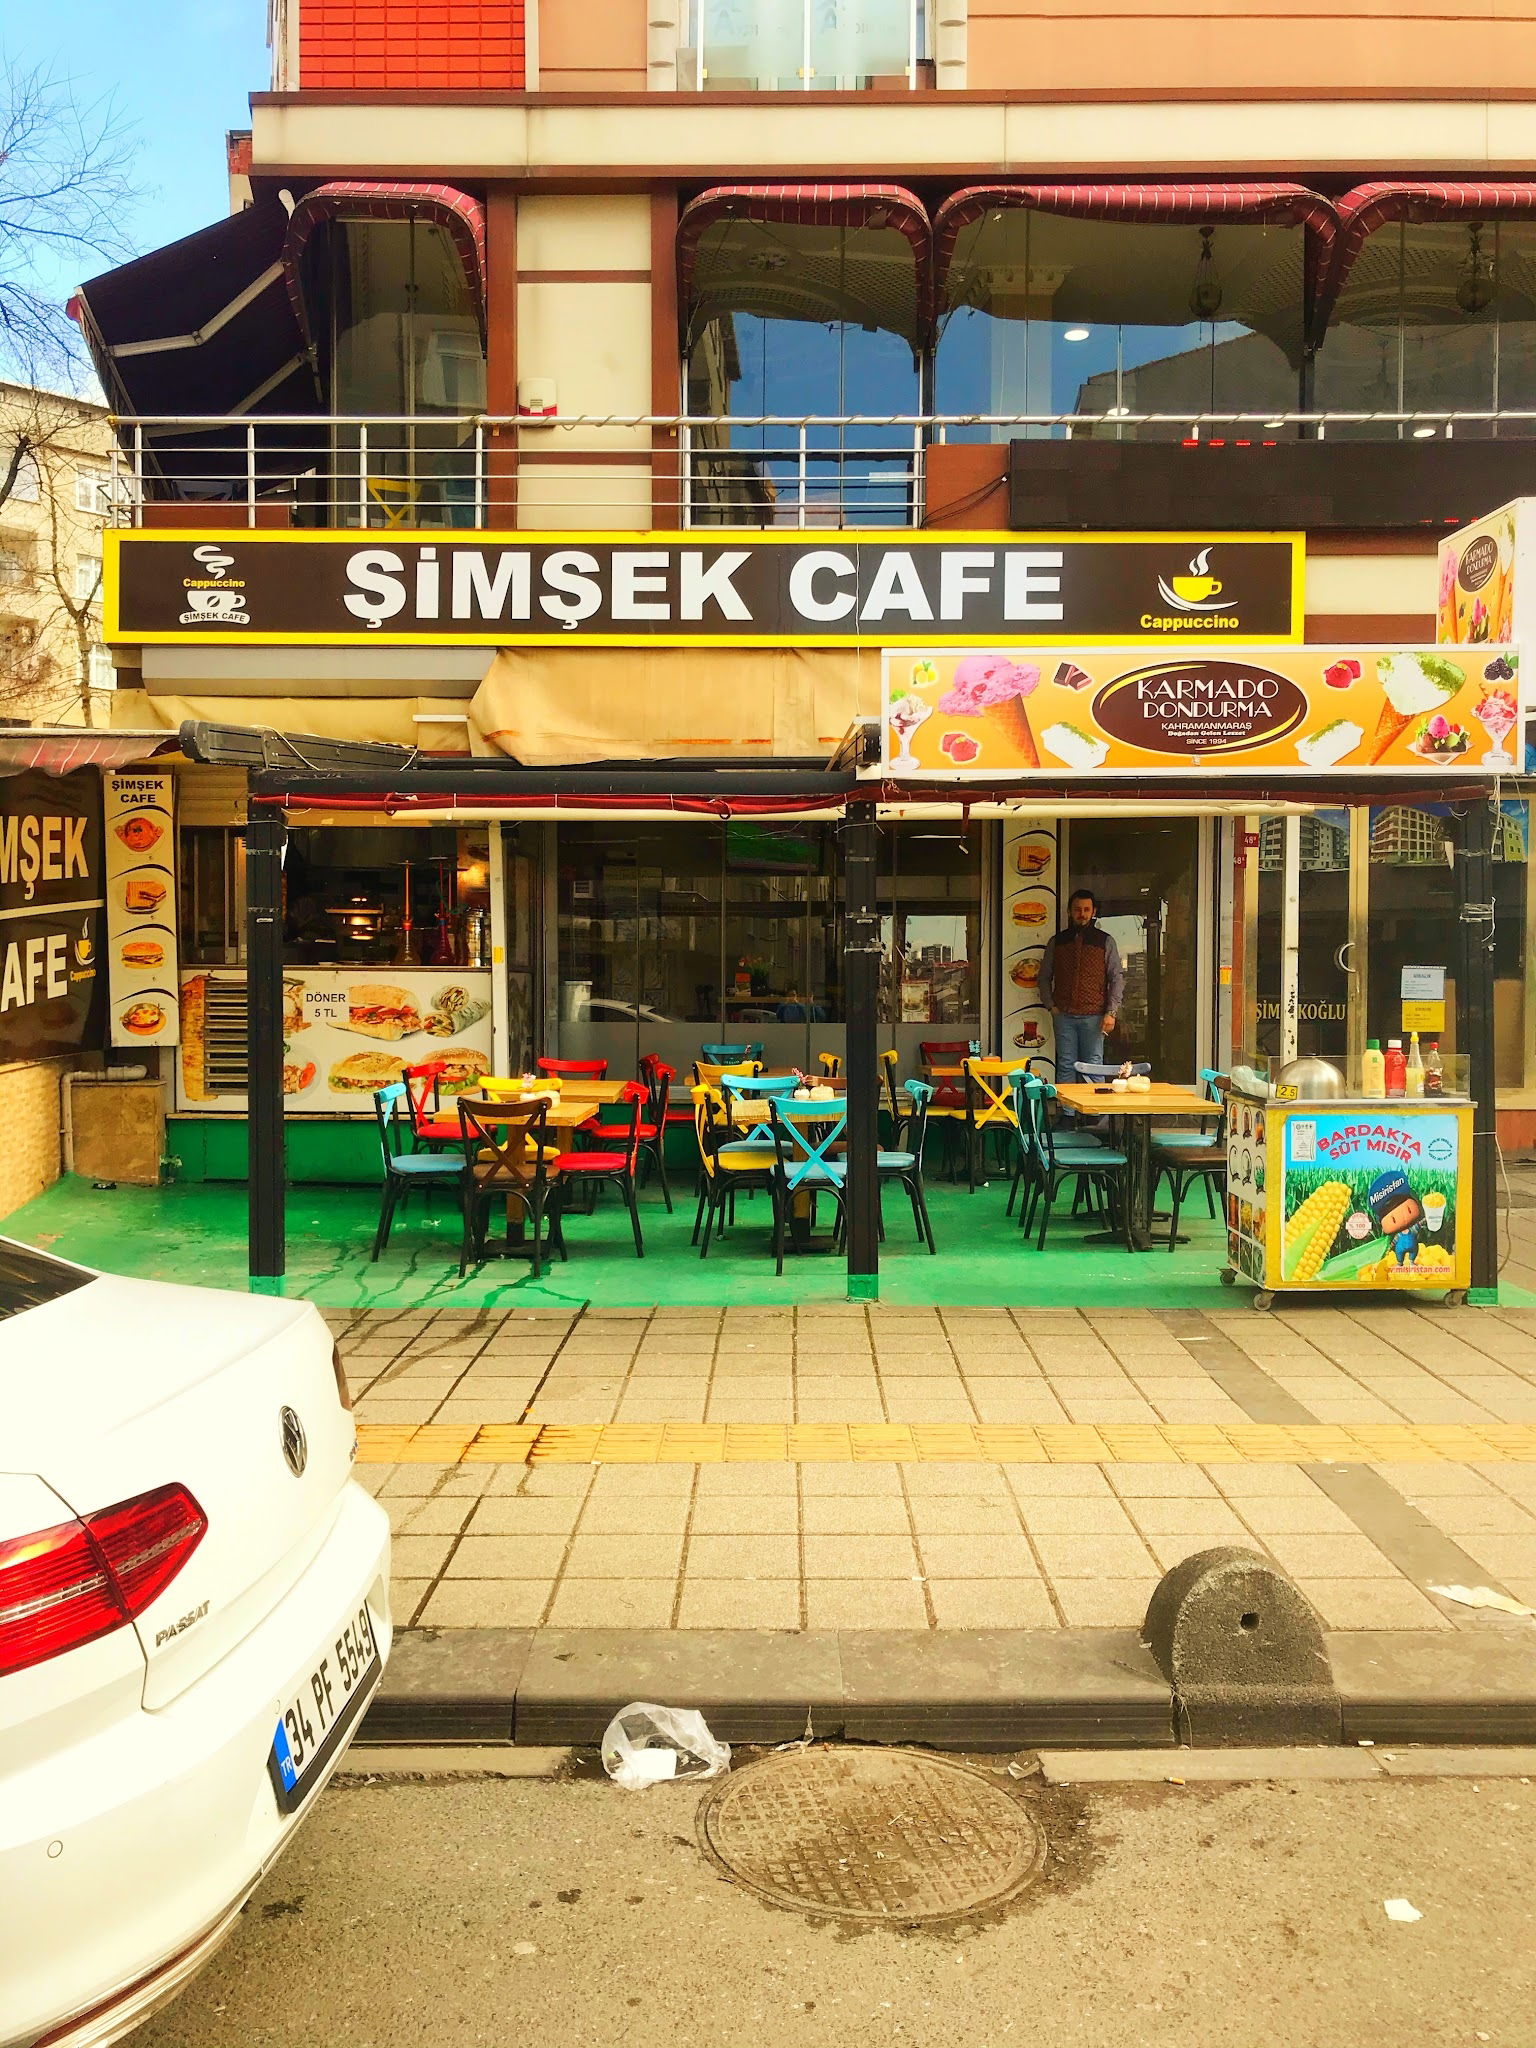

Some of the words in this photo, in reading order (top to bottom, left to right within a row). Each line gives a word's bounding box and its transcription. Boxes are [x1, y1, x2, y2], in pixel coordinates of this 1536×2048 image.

[183, 578, 245, 589] Cappuccino
[344, 547, 753, 630] ŞİMŞEK
[789, 551, 1063, 621] CAFE
[184, 612, 219, 622] ŞİMŞEK
[222, 612, 246, 622] CAFE
[1140, 614, 1240, 631] Cappuccino
[1138, 679, 1279, 699] KARMADO
[1143, 701, 1272, 718] DONDURMA
[1161, 722, 1252, 731] KAHRAMANMARAŞ
[112, 778, 164, 791] ŞİMŞEK
[120, 794, 156, 803] CAFE
[306, 991, 346, 1003] DÖNER
[314, 1008, 321, 1018] 5
[324, 1008, 337, 1018] TL
[1256, 999, 1346, 1024] ŞİMKOĞLU
[1316, 1123, 1421, 1157] BARDAKTA
[1329, 1139, 1361, 1161] SÜT
[1366, 1138, 1412, 1165] MISIR
[155, 1599, 211, 1648] PASSAT
[285, 1698, 315, 1768] 34
[310, 1657, 334, 1730] PF
[334, 1608, 372, 1692] 5549
[280, 1755, 293, 1777] TR
